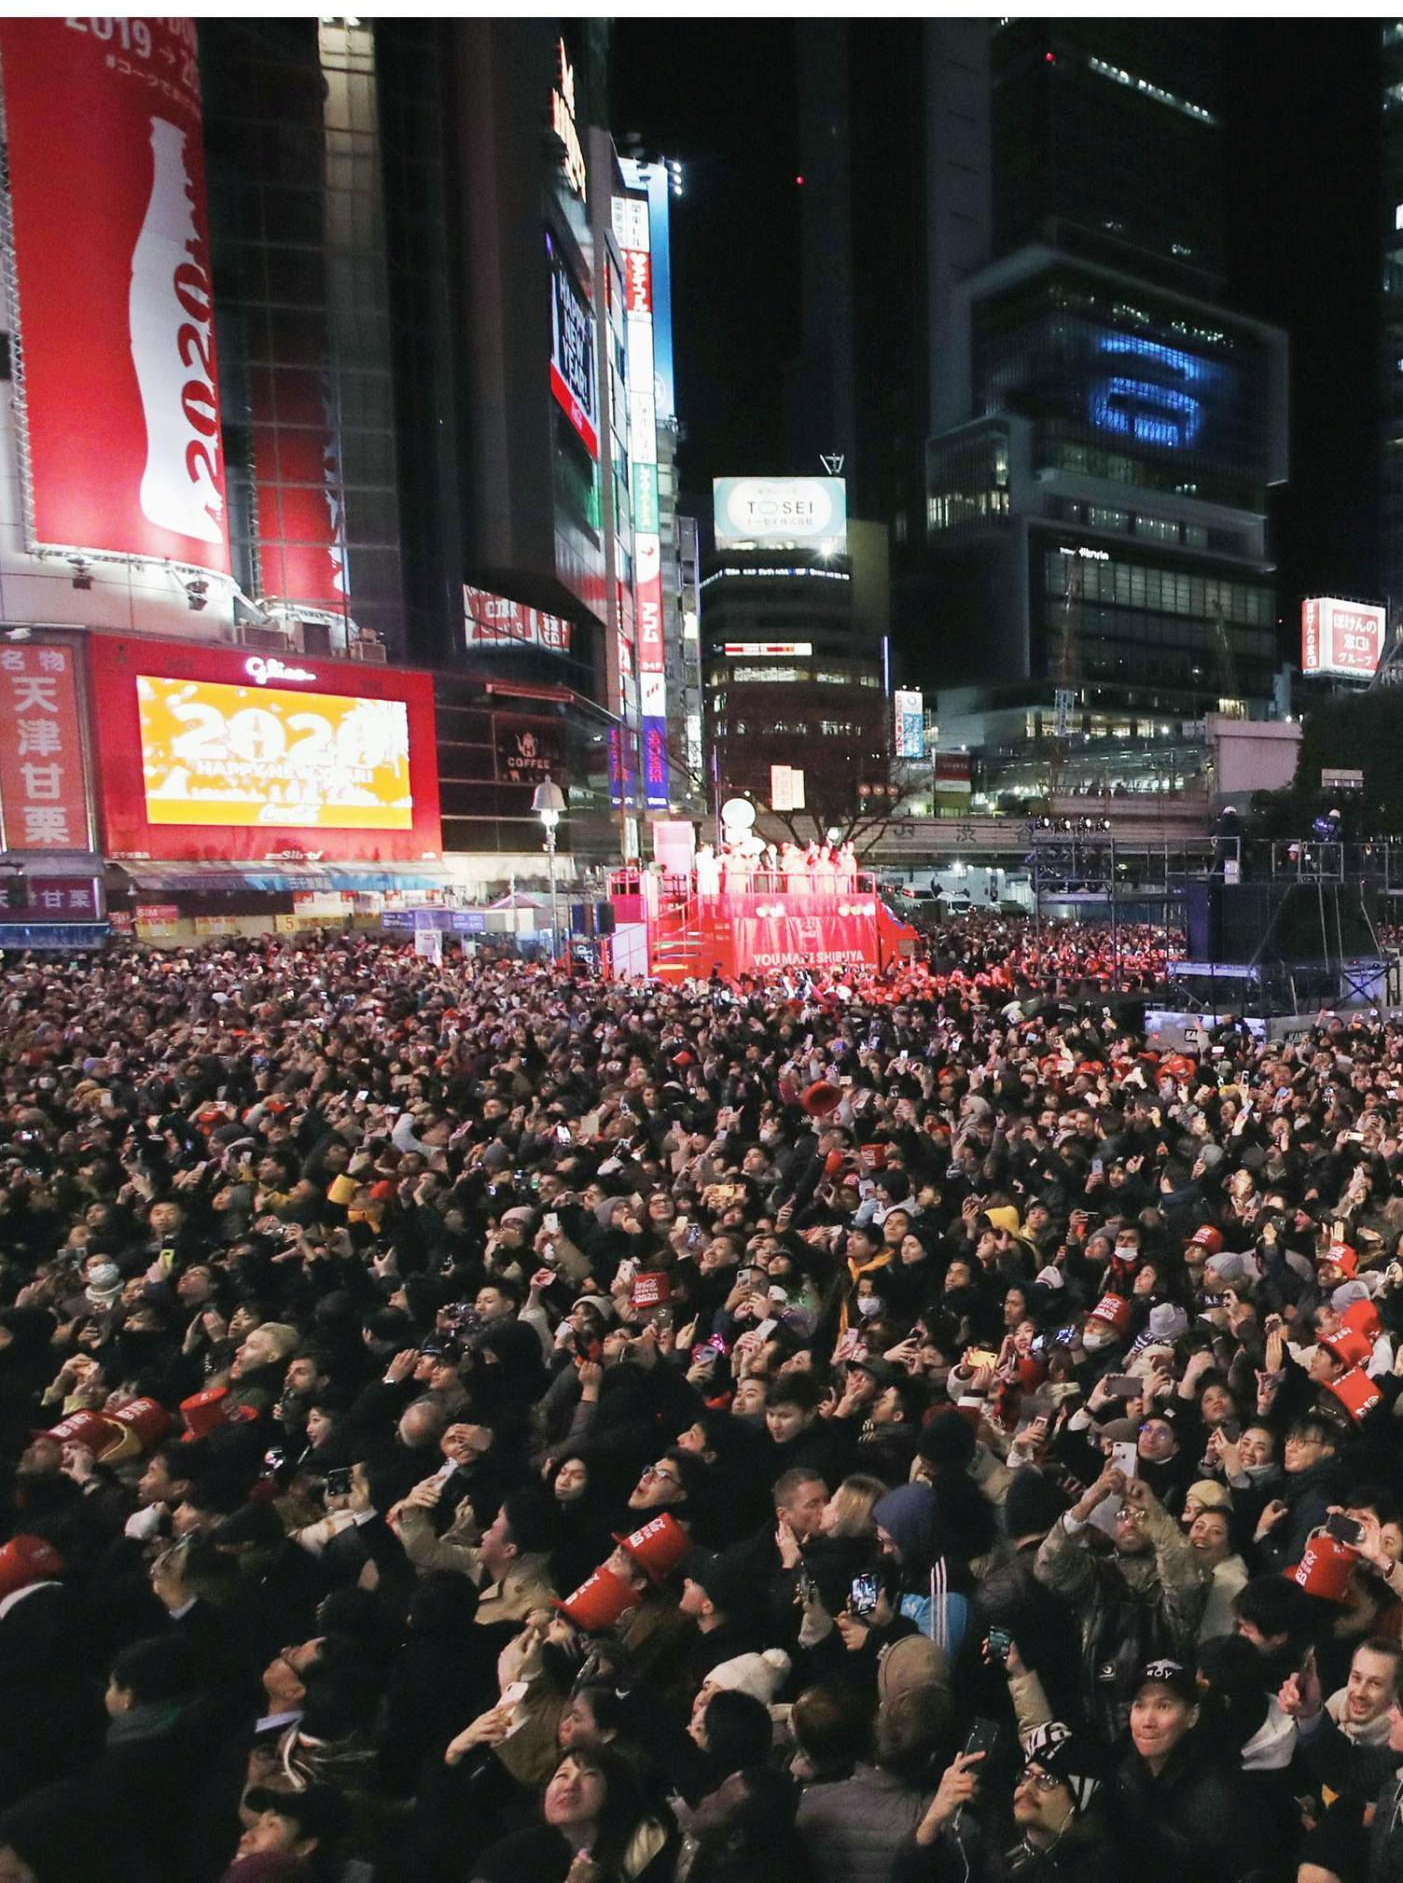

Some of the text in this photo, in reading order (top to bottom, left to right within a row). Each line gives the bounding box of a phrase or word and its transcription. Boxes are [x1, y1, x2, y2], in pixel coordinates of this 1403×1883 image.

[747, 501, 813, 514] TOSEI
[1334, 614, 1377, 635] ほけんの
[2, 649, 65, 672] 名物
[11, 676, 71, 843] 天津甘栗
[508, 757, 550, 779] COFFEE
[754, 954, 780, 966] YOU
[817, 950, 864, 964] SHIBUYA
